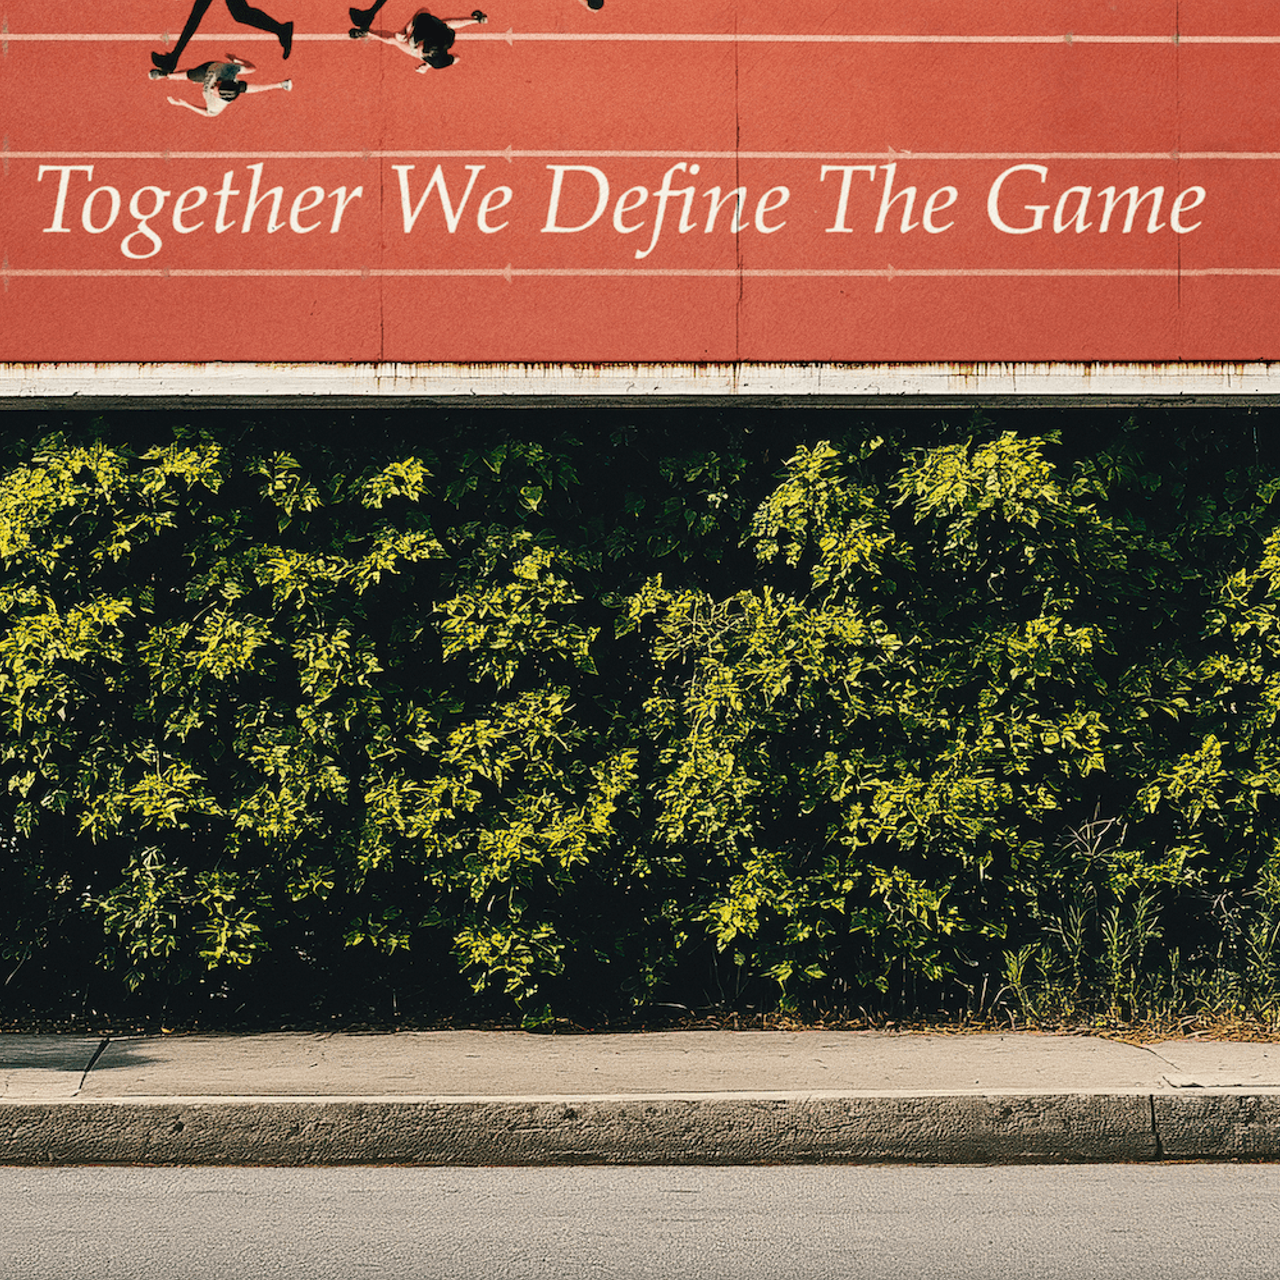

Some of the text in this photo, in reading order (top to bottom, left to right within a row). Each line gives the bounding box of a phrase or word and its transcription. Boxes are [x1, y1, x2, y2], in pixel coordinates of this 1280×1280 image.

[36, 162, 1206, 259] Together We Define The Game
